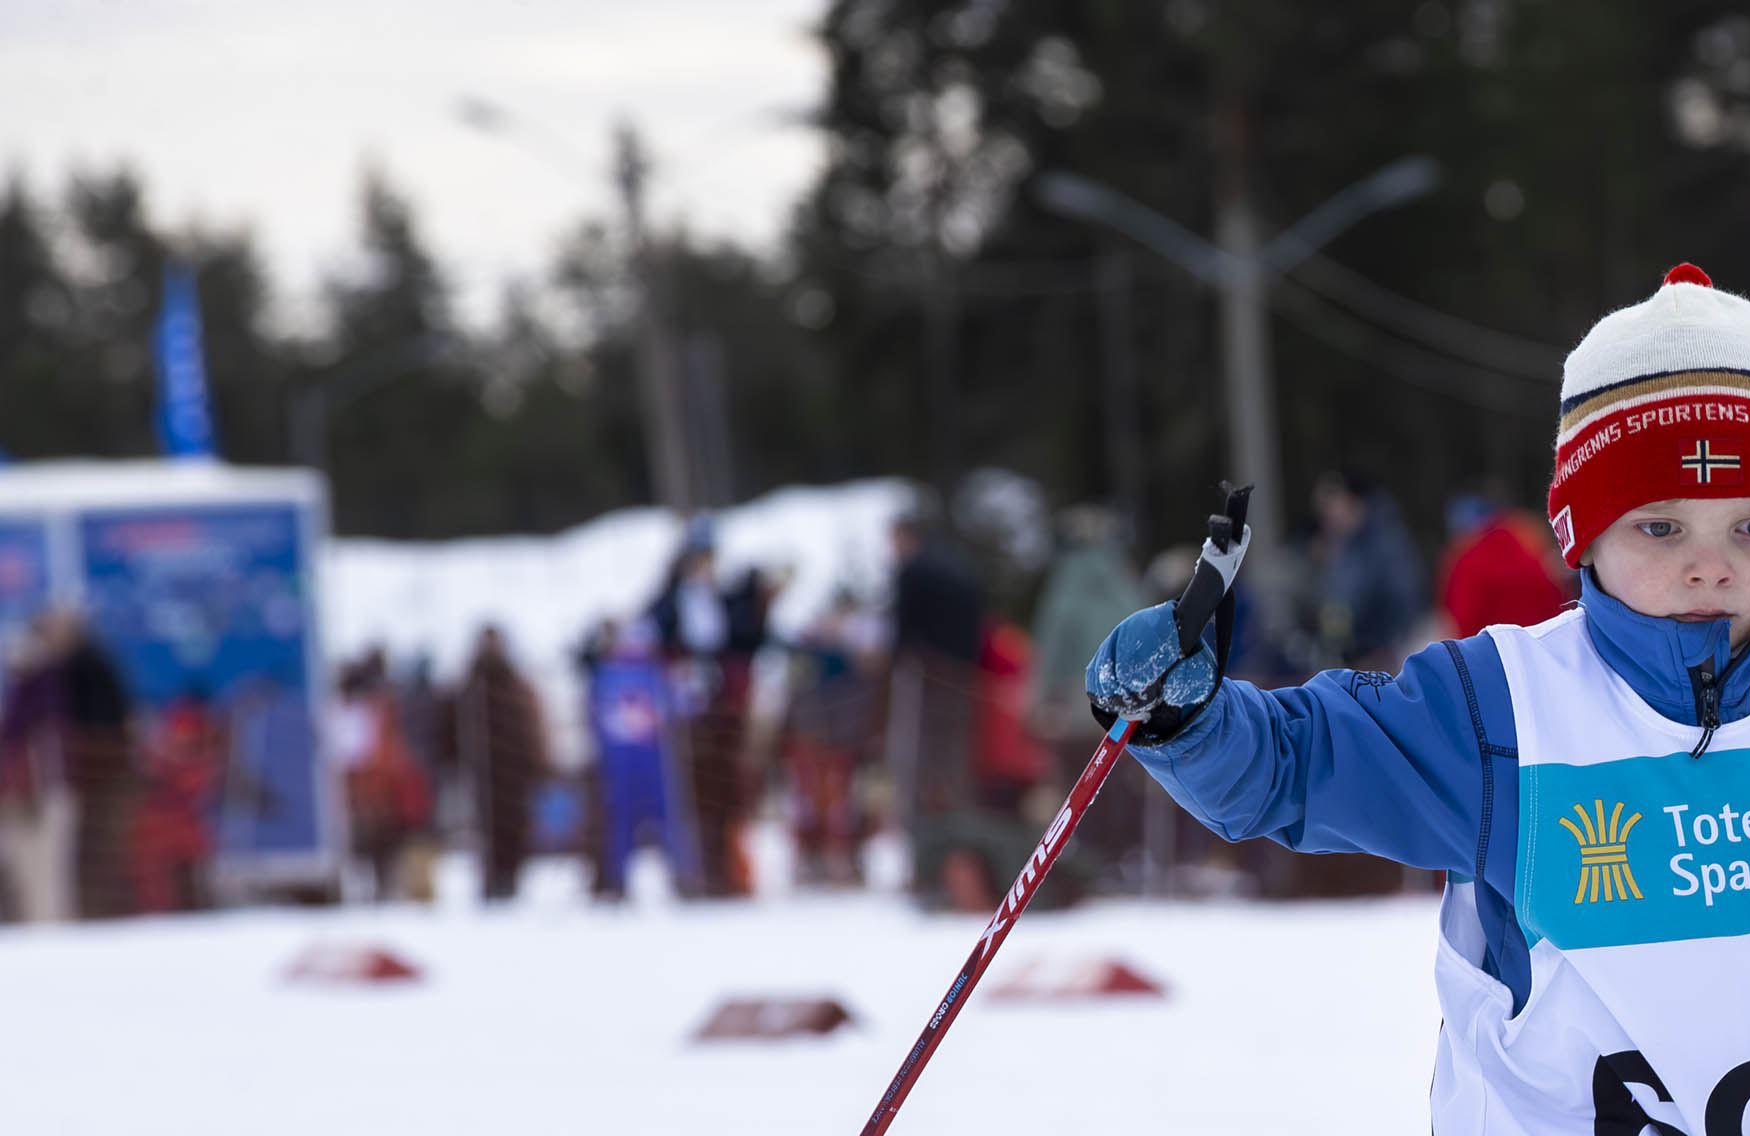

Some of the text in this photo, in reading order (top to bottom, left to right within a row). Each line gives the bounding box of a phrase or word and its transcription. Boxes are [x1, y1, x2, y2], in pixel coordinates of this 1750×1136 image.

[1626, 402, 1750, 434] SPORTENS
[929, 971, 969, 1030] JUNIOR CROSS
